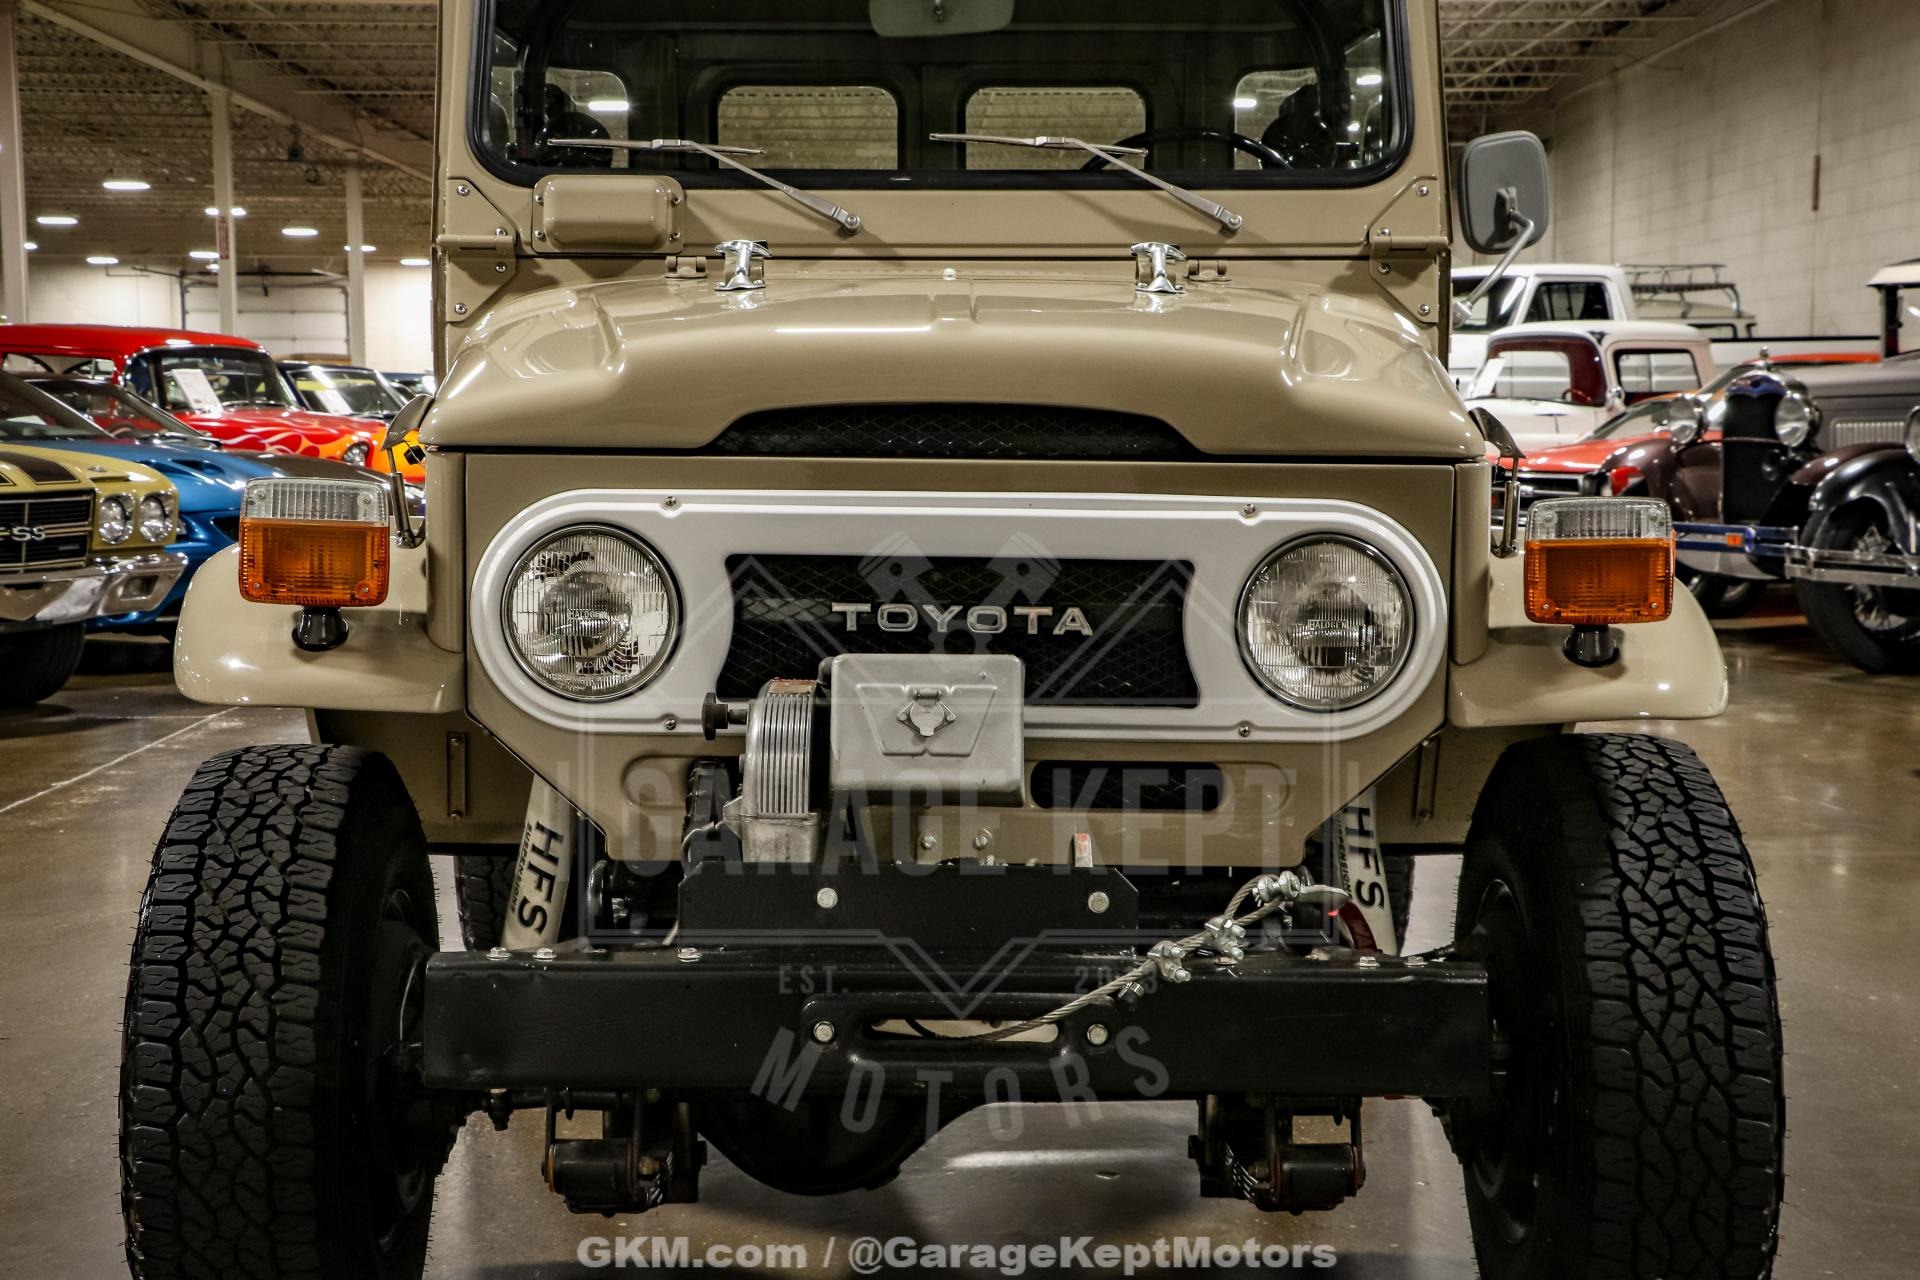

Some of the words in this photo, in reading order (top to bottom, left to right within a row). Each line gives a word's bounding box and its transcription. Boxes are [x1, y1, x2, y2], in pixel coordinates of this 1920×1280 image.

[11, 526, 46, 541] SS
[568, 610, 608, 620] HALOGEN
[832, 602, 1093, 636] TOYOTA
[1309, 620, 1348, 630] HALOGEN
[510, 821, 532, 914] SUSPENSIONS
[1343, 806, 1385, 910] HFS
[517, 821, 564, 936] HFS
